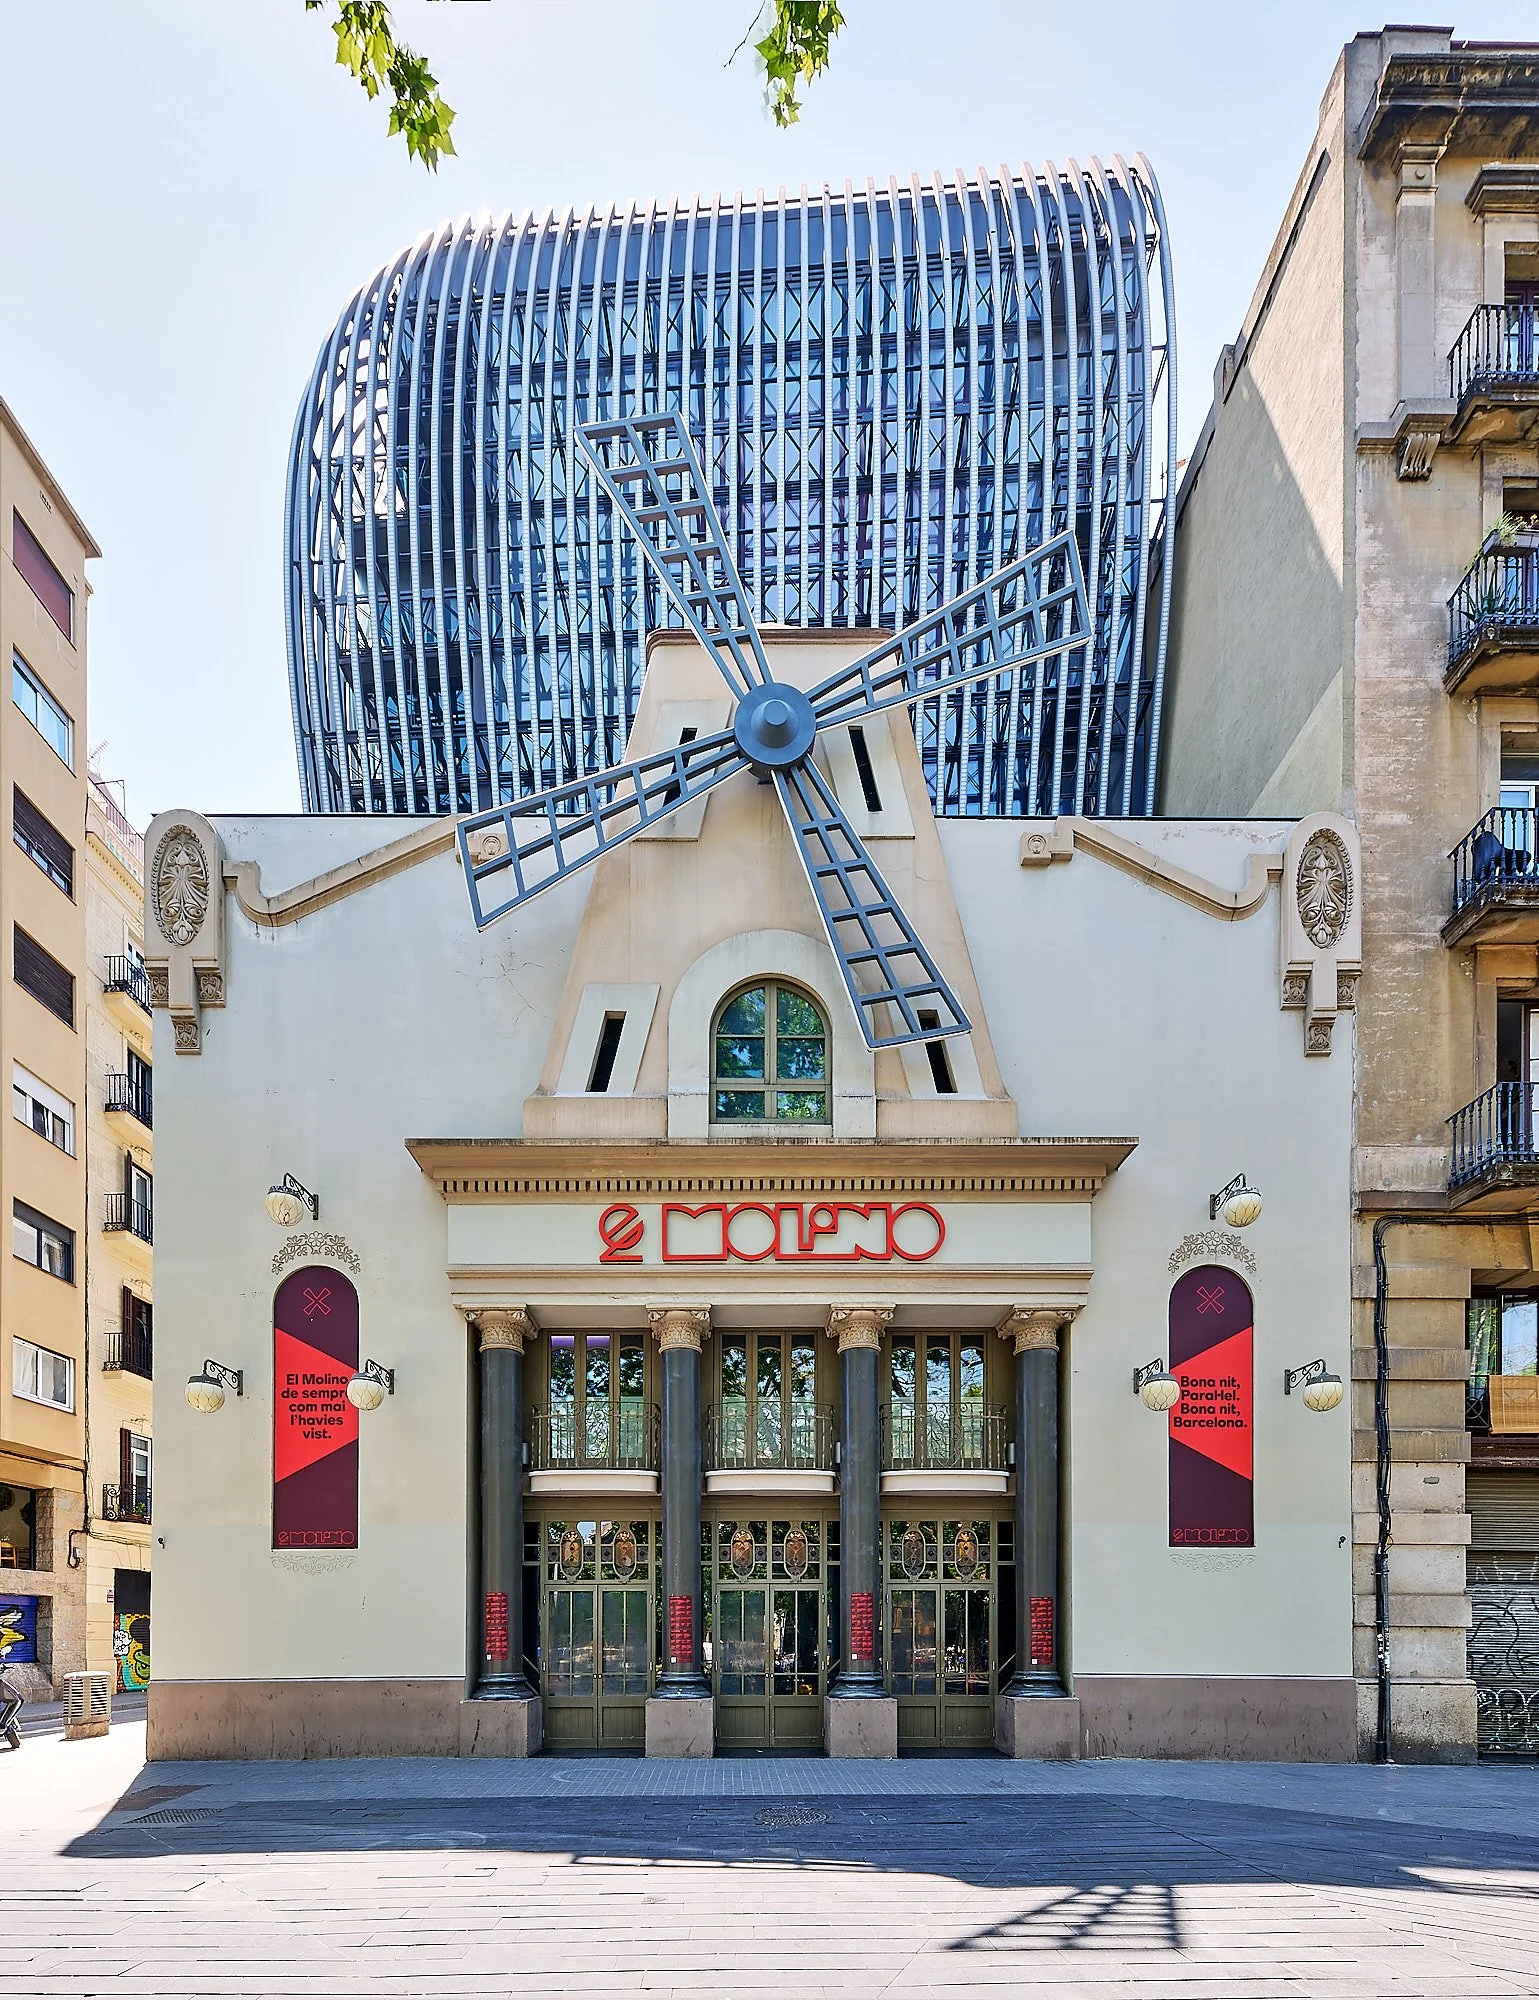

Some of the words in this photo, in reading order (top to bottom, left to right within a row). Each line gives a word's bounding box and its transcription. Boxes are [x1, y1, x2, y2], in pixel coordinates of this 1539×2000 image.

[286, 1374, 299, 1385] El
[302, 1373, 348, 1385] Molino
[1180, 1376, 1216, 1387] Bona
[1219, 1376, 1240, 1390] nit,
[281, 1388, 299, 1399] de
[301, 1389, 346, 1401] sempr
[288, 1403, 318, 1412] com
[320, 1400, 346, 1412] mai
[1180, 1403, 1216, 1415] Bona
[1219, 1403, 1240, 1417] nit,
[1173, 1416, 1247, 1428] Barcelona.
[302, 1428, 332, 1439] vist.
